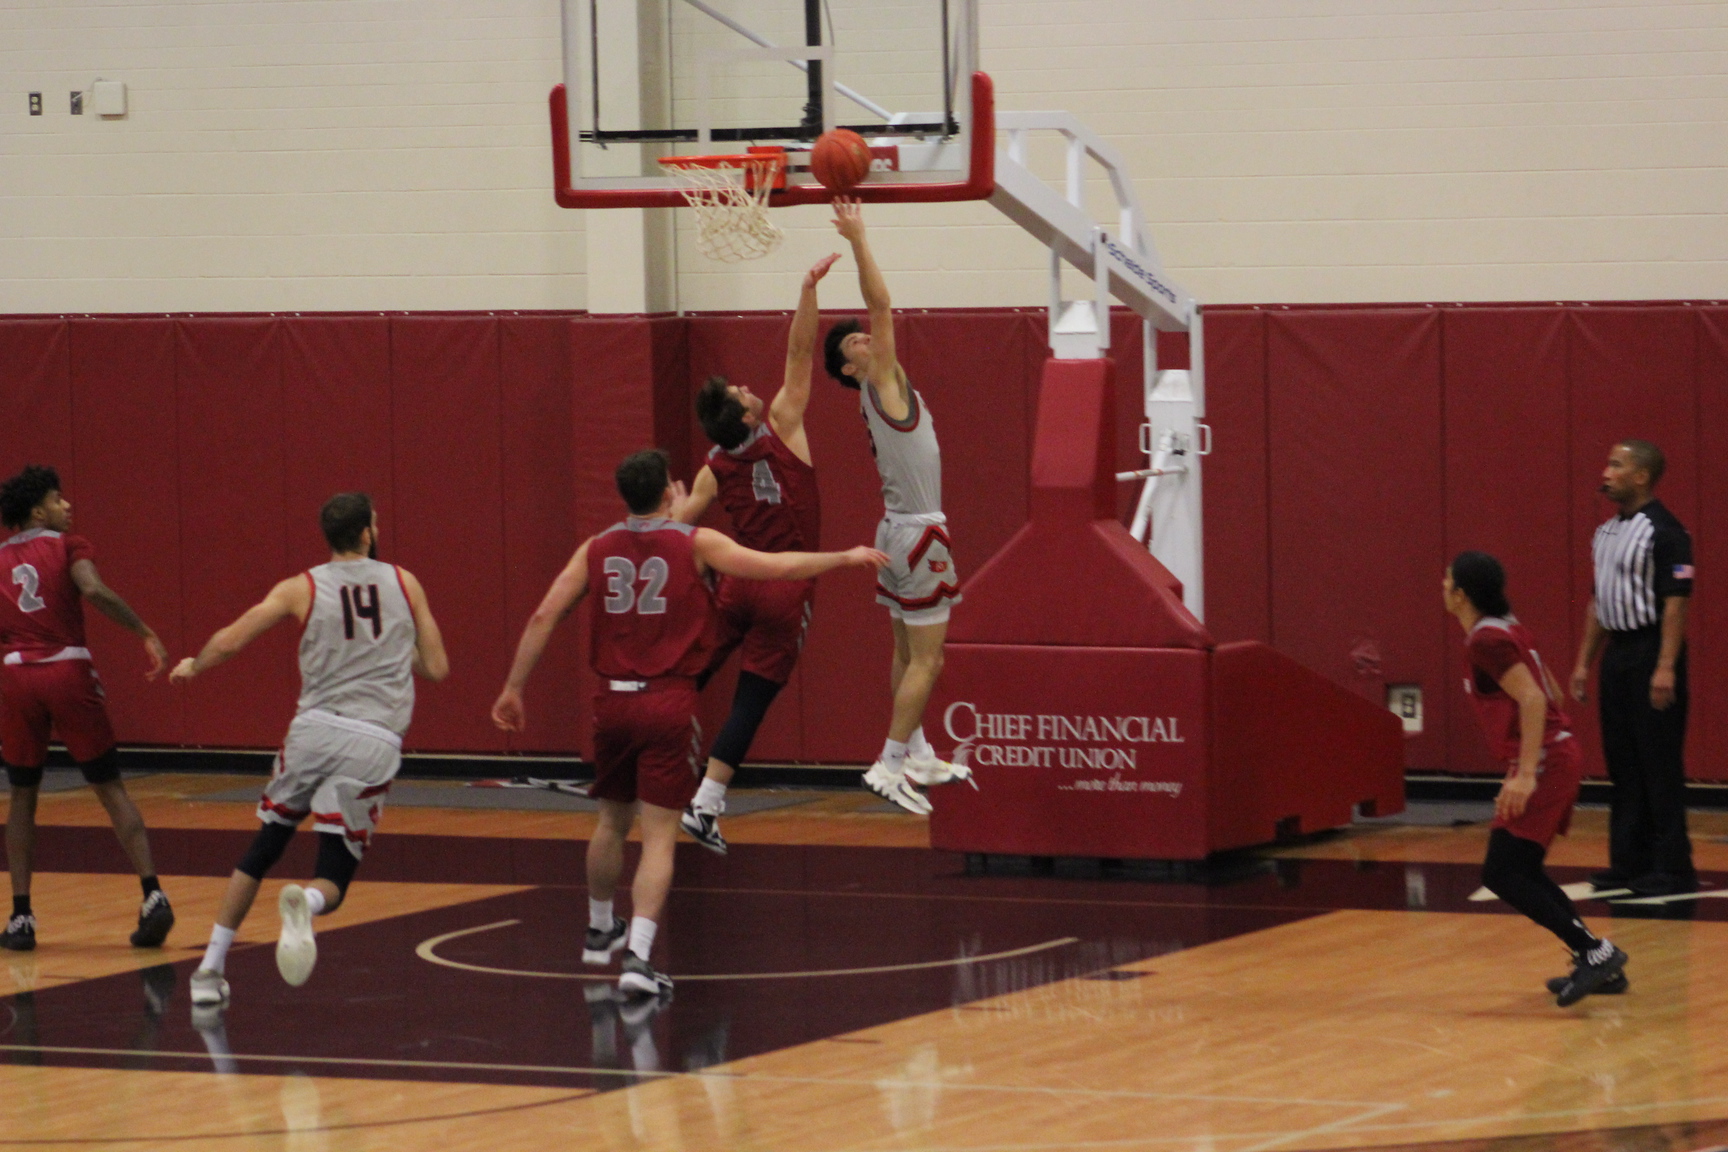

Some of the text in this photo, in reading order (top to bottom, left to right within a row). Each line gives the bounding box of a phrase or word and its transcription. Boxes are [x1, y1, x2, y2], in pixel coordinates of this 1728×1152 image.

[752, 459, 781, 505] 4
[12, 563, 46, 613] 2
[603, 556, 669, 614] 32
[340, 584, 383, 640] 14
[944, 701, 1185, 743] CHIEF FINANCIAL
[975, 744, 1137, 770] CREDIT UNION
[1139, 781, 1183, 798] money
